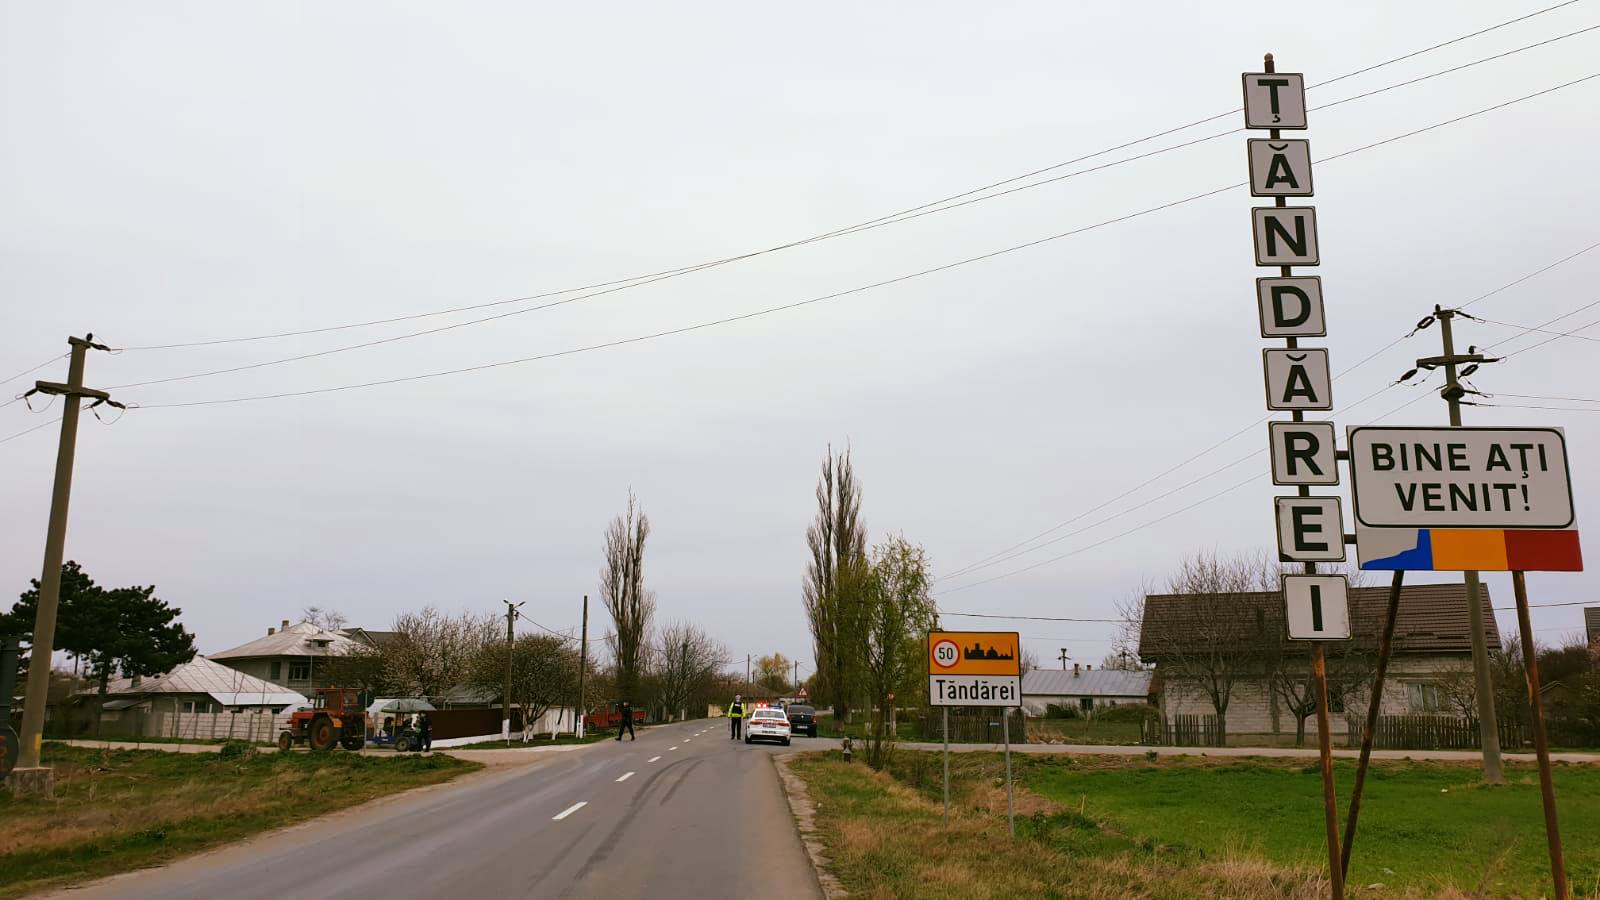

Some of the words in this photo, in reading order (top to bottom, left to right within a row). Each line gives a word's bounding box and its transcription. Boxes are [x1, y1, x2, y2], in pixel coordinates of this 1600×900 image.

[1257, 79, 1328, 631] ȚĂNDĂREI
[1371, 443, 1470, 471] BINE
[1486, 443, 1548, 478] AȚI
[1394, 483, 1530, 512] VENIT!
[938, 647, 953, 660] 50
[936, 679, 1015, 703] Țăndărei
